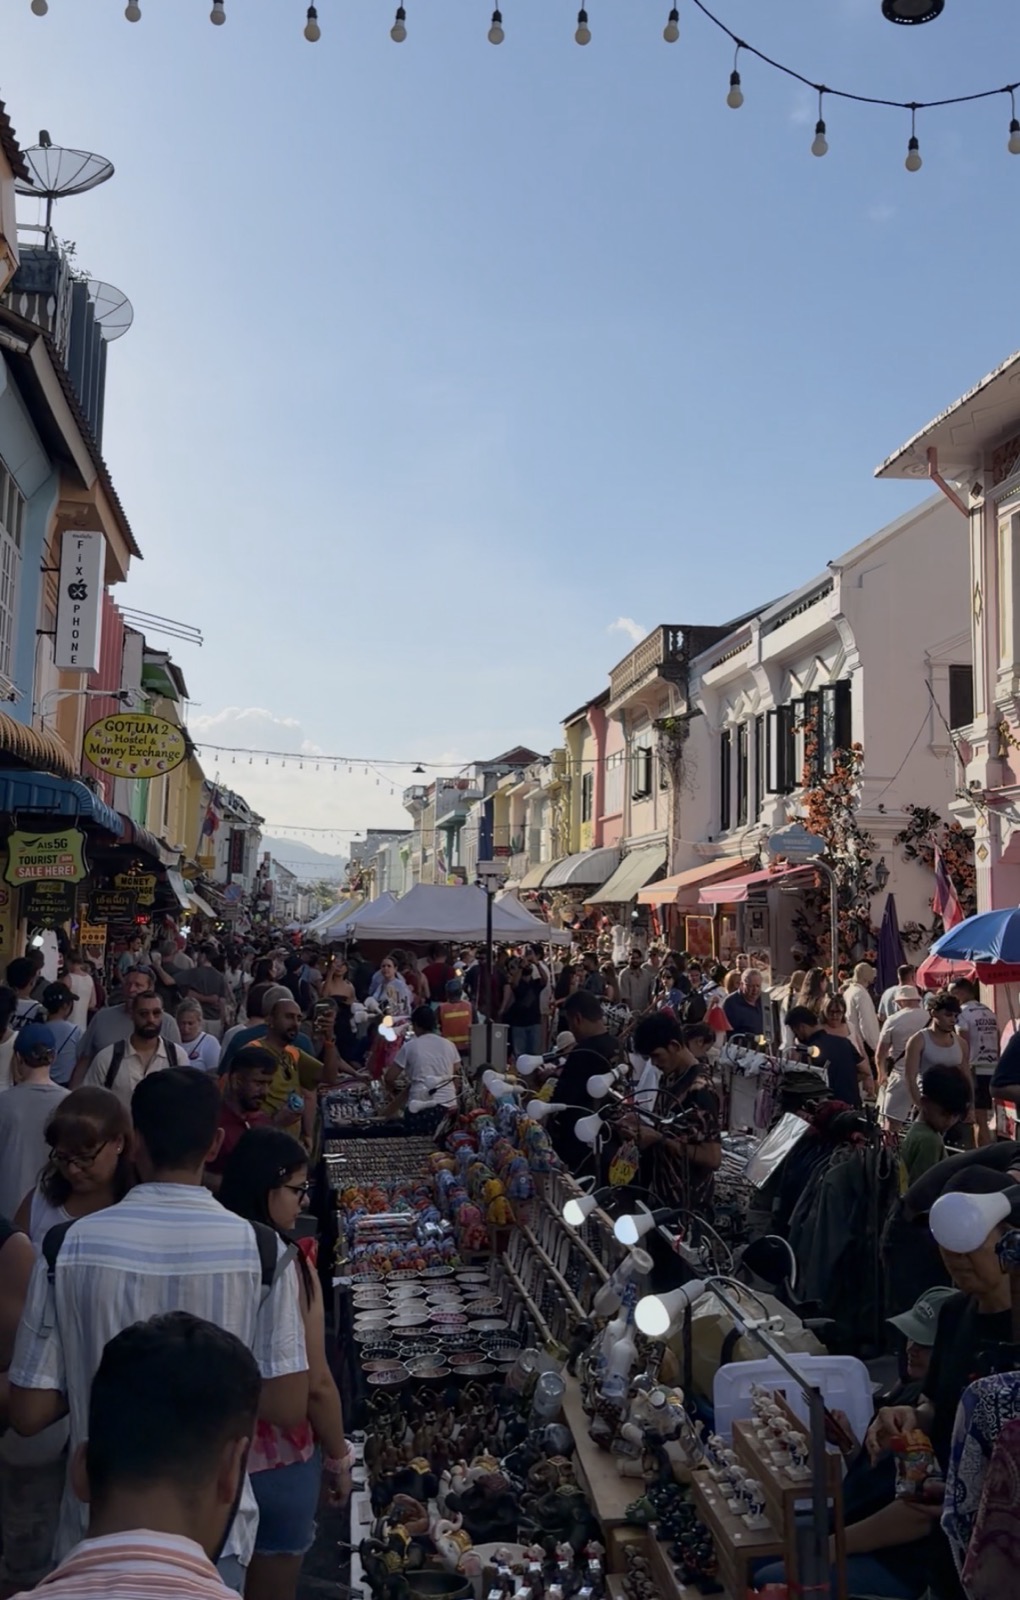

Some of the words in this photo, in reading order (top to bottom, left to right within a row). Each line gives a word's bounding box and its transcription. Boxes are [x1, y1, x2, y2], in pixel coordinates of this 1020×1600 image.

[71, 604, 80, 664] PHONE
[104, 720, 159, 734] GOTUM
[161, 724, 169, 735] 2
[114, 733, 147, 745] Hostel
[88, 743, 126, 759] Money
[128, 745, 181, 762] Exchange
[54, 838, 68, 849] 5G
[18, 854, 58, 865] TOURIST
[18, 866, 43, 878] SALE
[45, 865, 74, 877] HERE!
